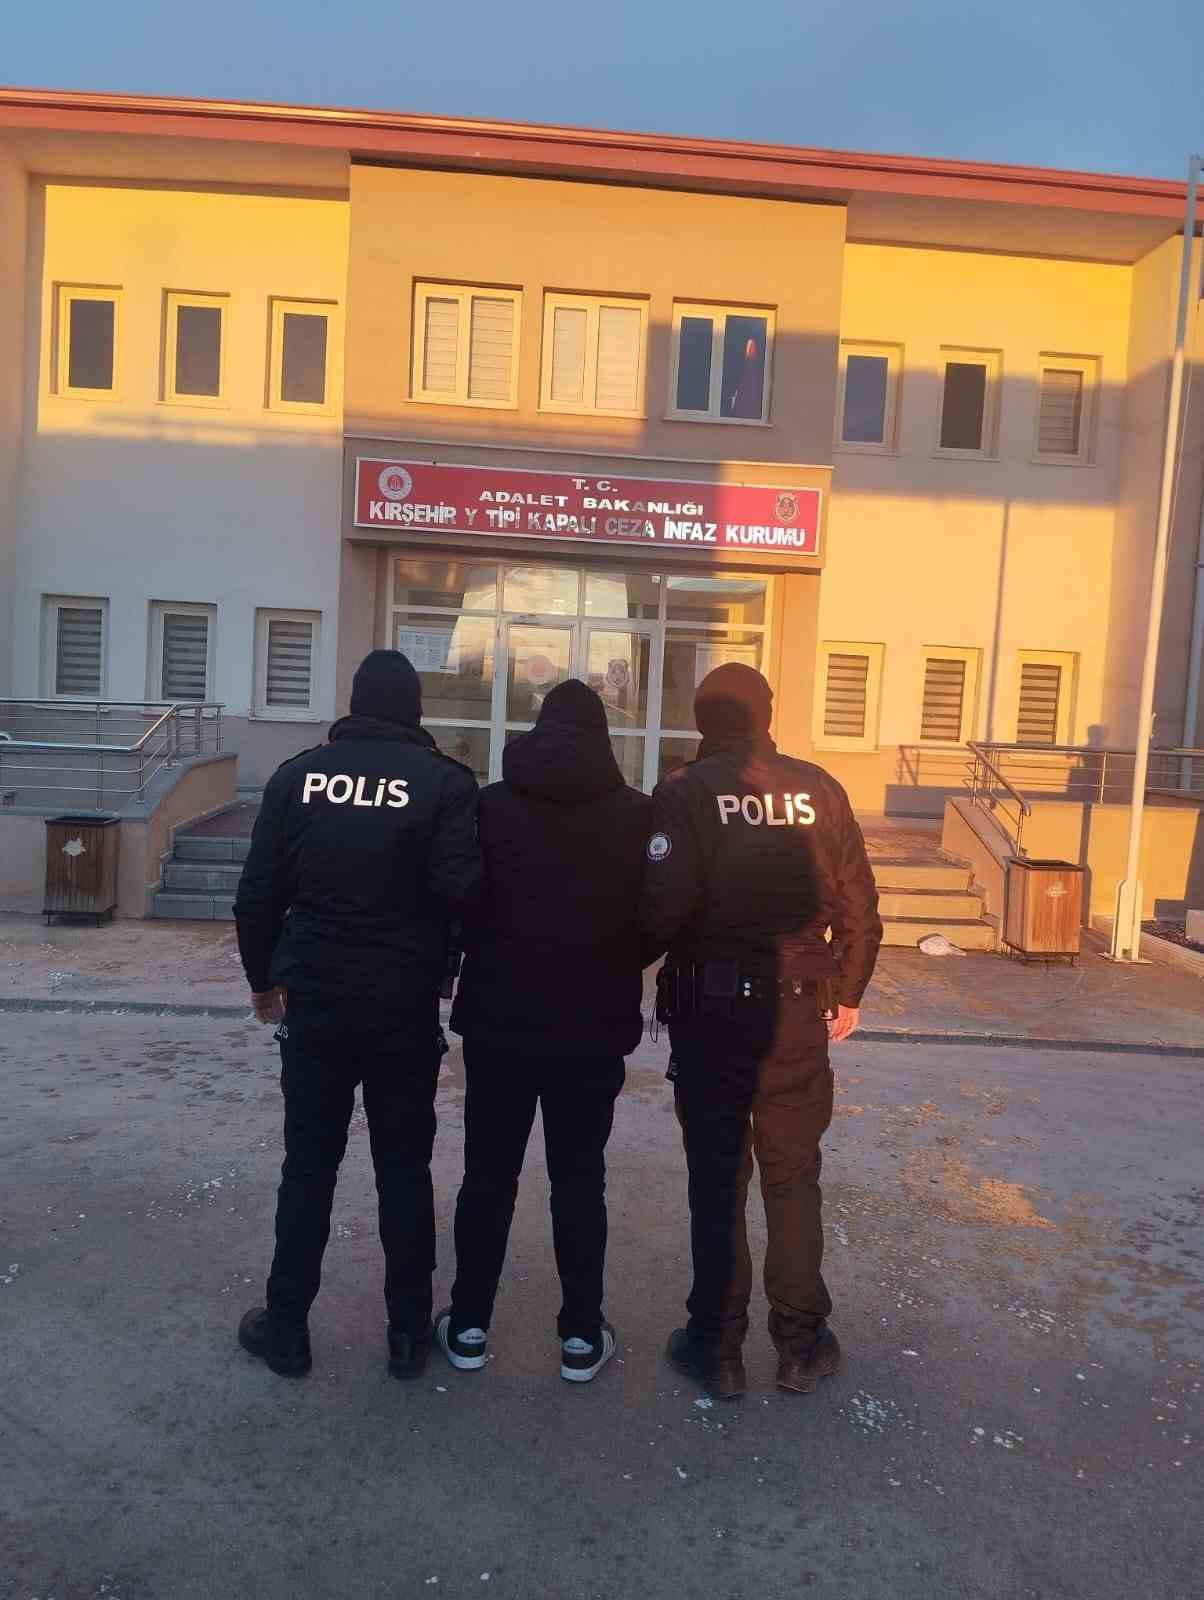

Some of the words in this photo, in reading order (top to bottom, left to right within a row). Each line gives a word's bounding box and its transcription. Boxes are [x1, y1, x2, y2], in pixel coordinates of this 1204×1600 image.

[479, 490, 569, 508] ADALET
[583, 496, 704, 516] BAKANLIĞI
[369, 501, 457, 526] KIRŞEHİR
[464, 507, 479, 526] Y
[486, 505, 521, 529] TİPİ
[527, 511, 597, 536] KAPALI
[604, 517, 656, 539] CEZA
[664, 516, 717, 542] İNFAZ
[725, 523, 806, 547] KURUMU
